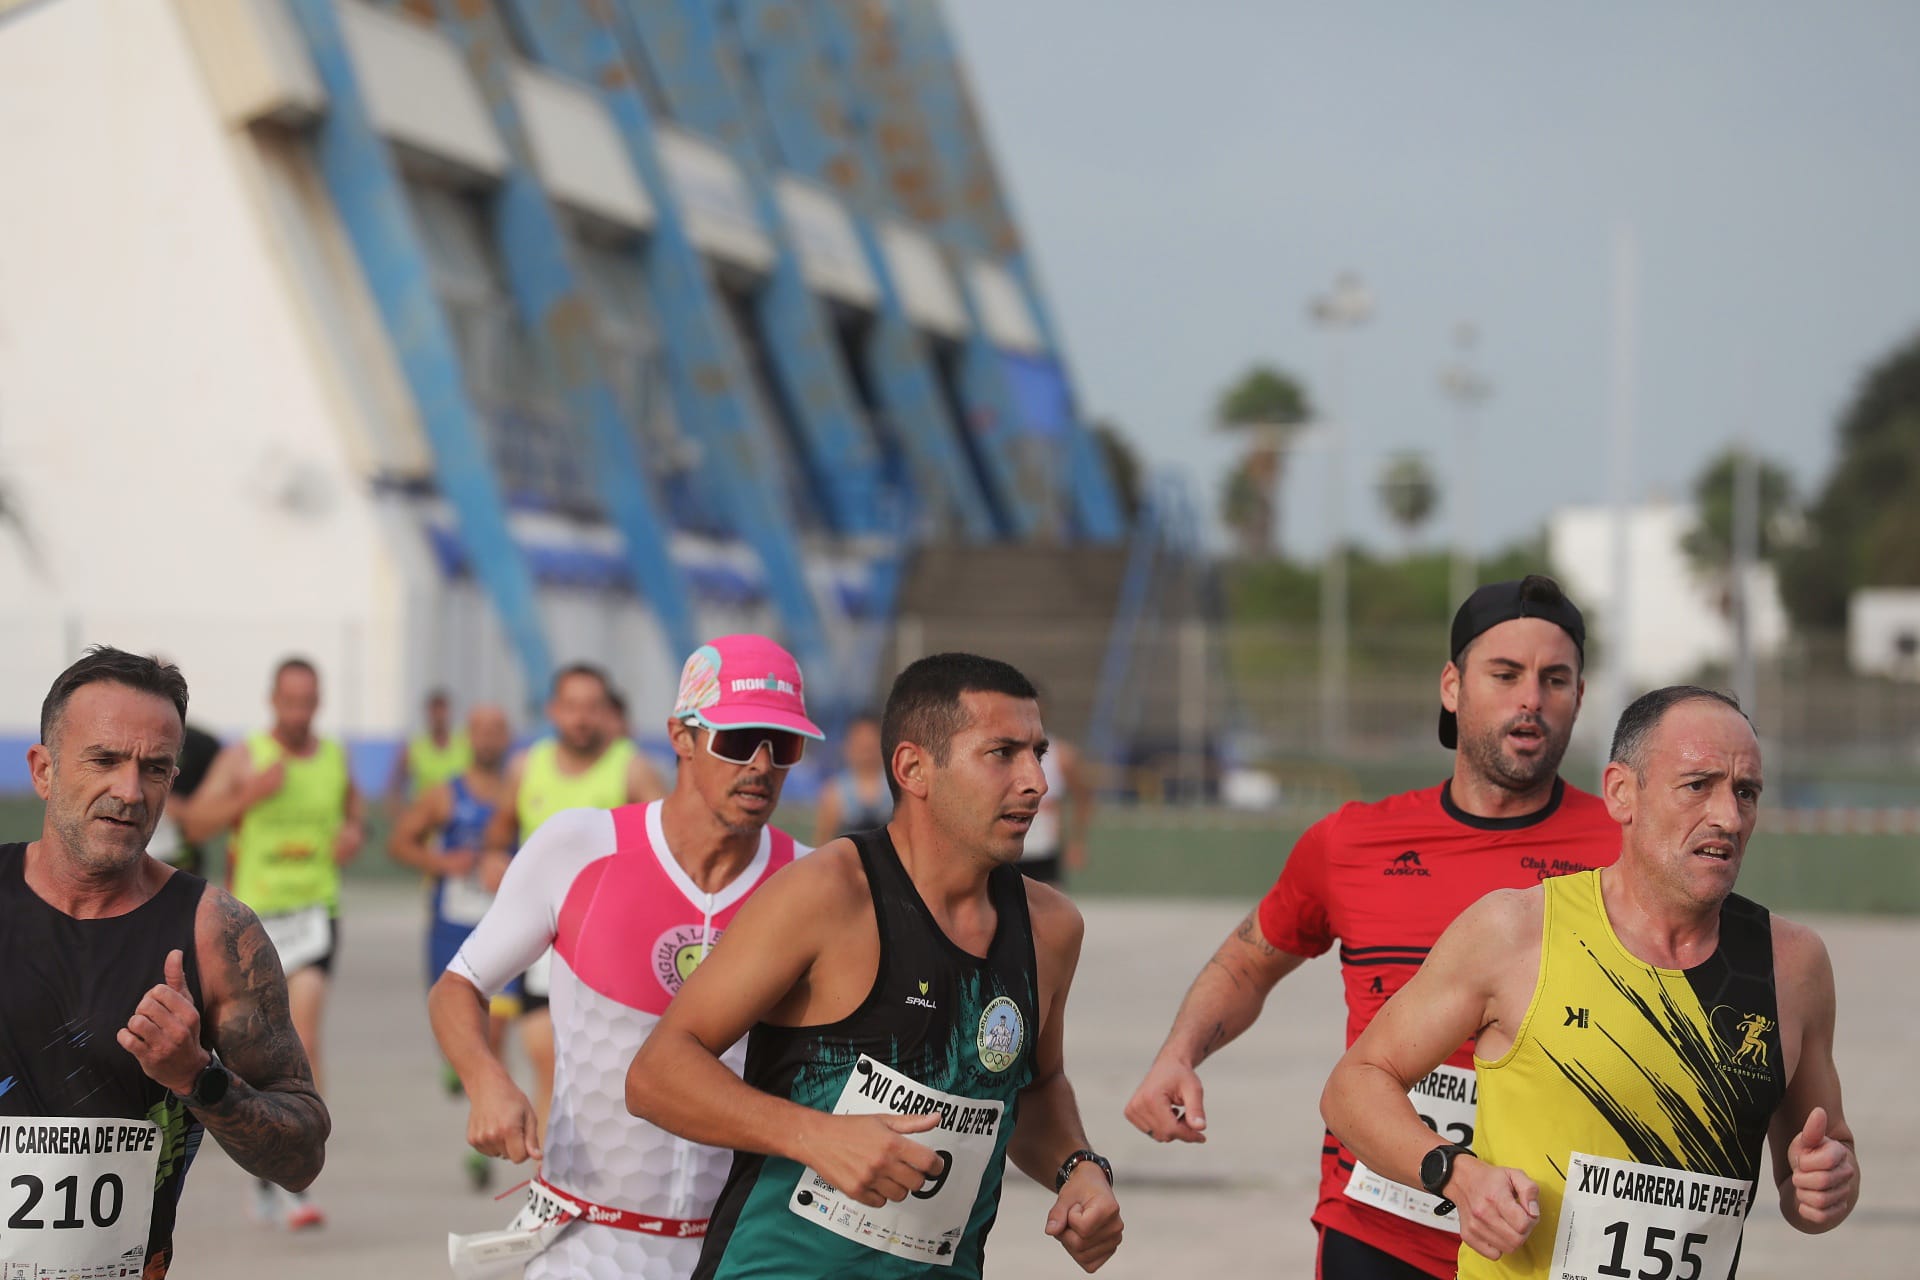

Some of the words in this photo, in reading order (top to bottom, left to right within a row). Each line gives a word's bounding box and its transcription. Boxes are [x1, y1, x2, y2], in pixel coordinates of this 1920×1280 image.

[1520, 857, 1547, 869] Club
[858, 1072, 893, 1105] XVI
[955, 1106, 977, 1135] DE
[970, 1108, 1000, 1137] PEPE
[16, 1126, 90, 1154] CARRERA
[95, 1126, 114, 1153] DE
[117, 1127, 156, 1152] PEPE
[8, 1173, 124, 1229] 210
[1579, 1164, 1610, 1195] XVI
[1613, 1169, 1684, 1209] CARRERA
[1688, 1182, 1711, 1213] DE
[1710, 1185, 1746, 1218] PEPE
[1597, 1221, 1709, 1280] 155
